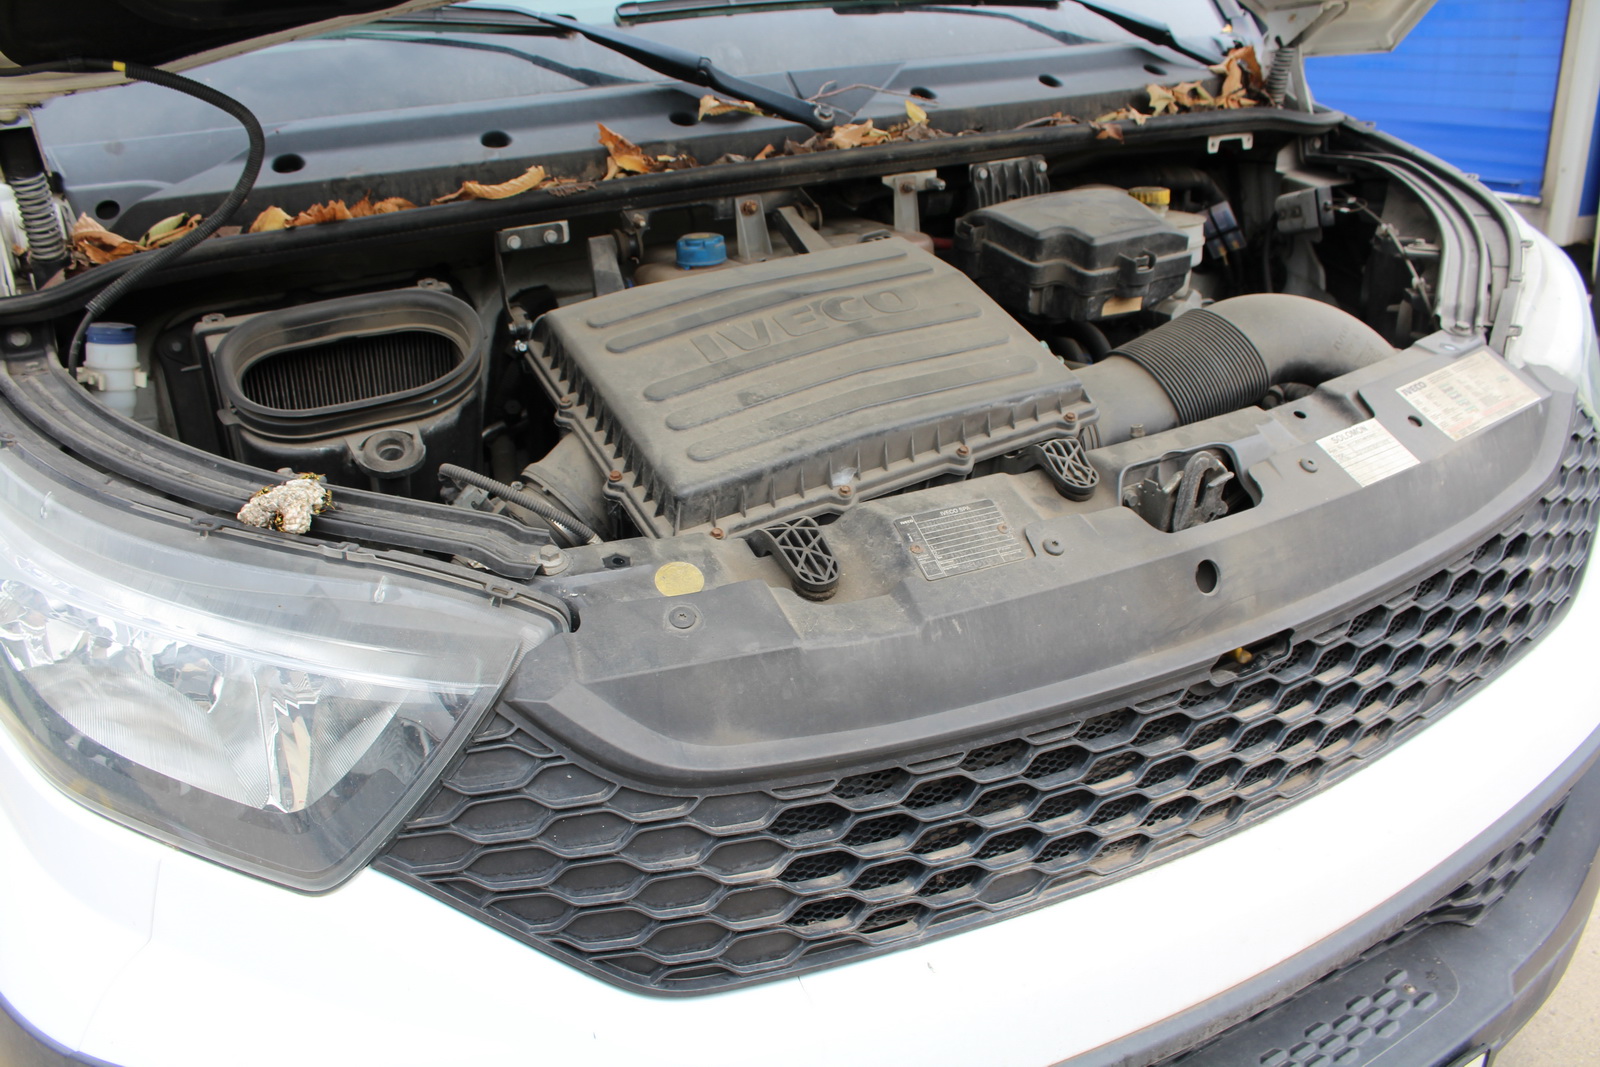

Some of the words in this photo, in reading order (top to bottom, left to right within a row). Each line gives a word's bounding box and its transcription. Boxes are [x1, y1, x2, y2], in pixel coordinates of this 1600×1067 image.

[690, 291, 919, 364] IVECO
[1401, 381, 1427, 396] IVECO
[1331, 425, 1368, 444] SOLOMON
[940, 507, 958, 516] IVECO
